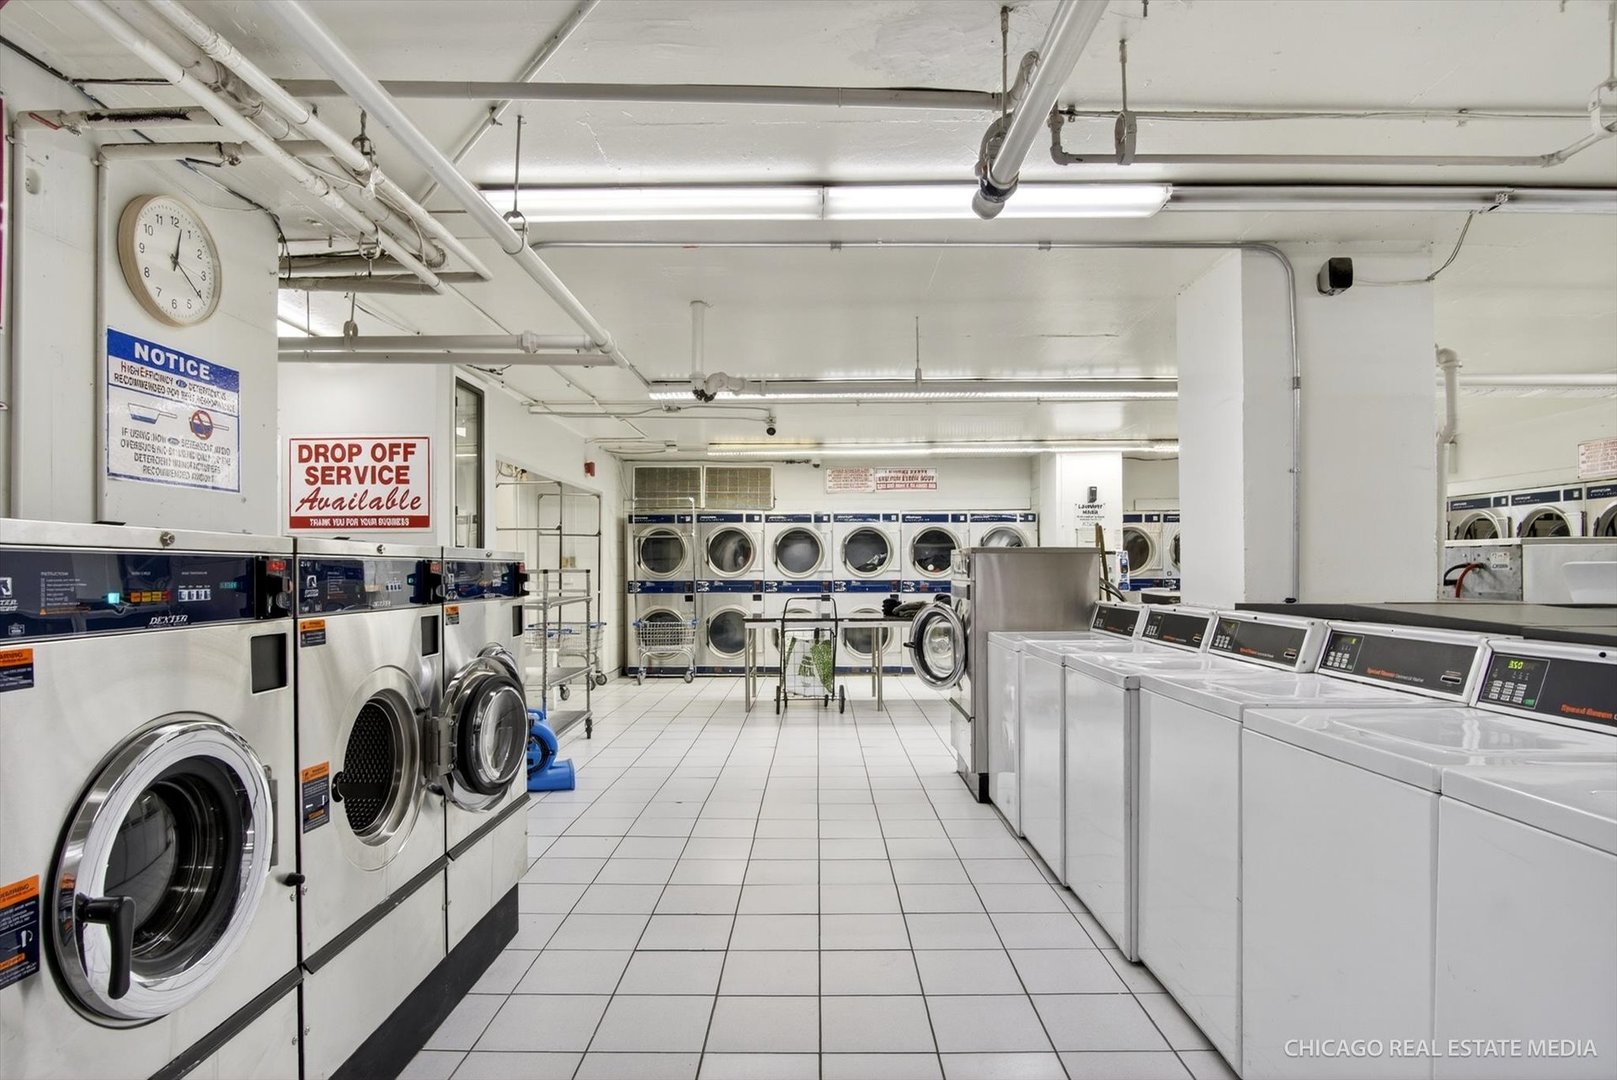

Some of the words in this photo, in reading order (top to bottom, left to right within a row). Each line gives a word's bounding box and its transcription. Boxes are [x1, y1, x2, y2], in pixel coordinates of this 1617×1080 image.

[156, 214, 164, 226] 11
[170, 216, 180, 228] 12
[144, 224, 154, 236] 10
[188, 230, 192, 239] 1
[138, 242, 145, 254] 9
[197, 249, 202, 260] 2
[144, 266, 150, 278] 8
[200, 270, 206, 281] 3
[156, 286, 162, 298] 7
[172, 298, 177, 309] 6
[187, 298, 192, 309] 5
[134, 342, 210, 380] NOTICE
[122, 427, 128, 436] IF
[298, 443, 362, 464] DROP
[370, 442, 416, 463] OFF
[304, 465, 410, 486] SERVICE
[295, 486, 422, 512] Available
[310, 518, 331, 526] THANK
[332, 518, 345, 526] YOU
[346, 518, 359, 526] FOR
[149, 614, 188, 625] DEXTER
